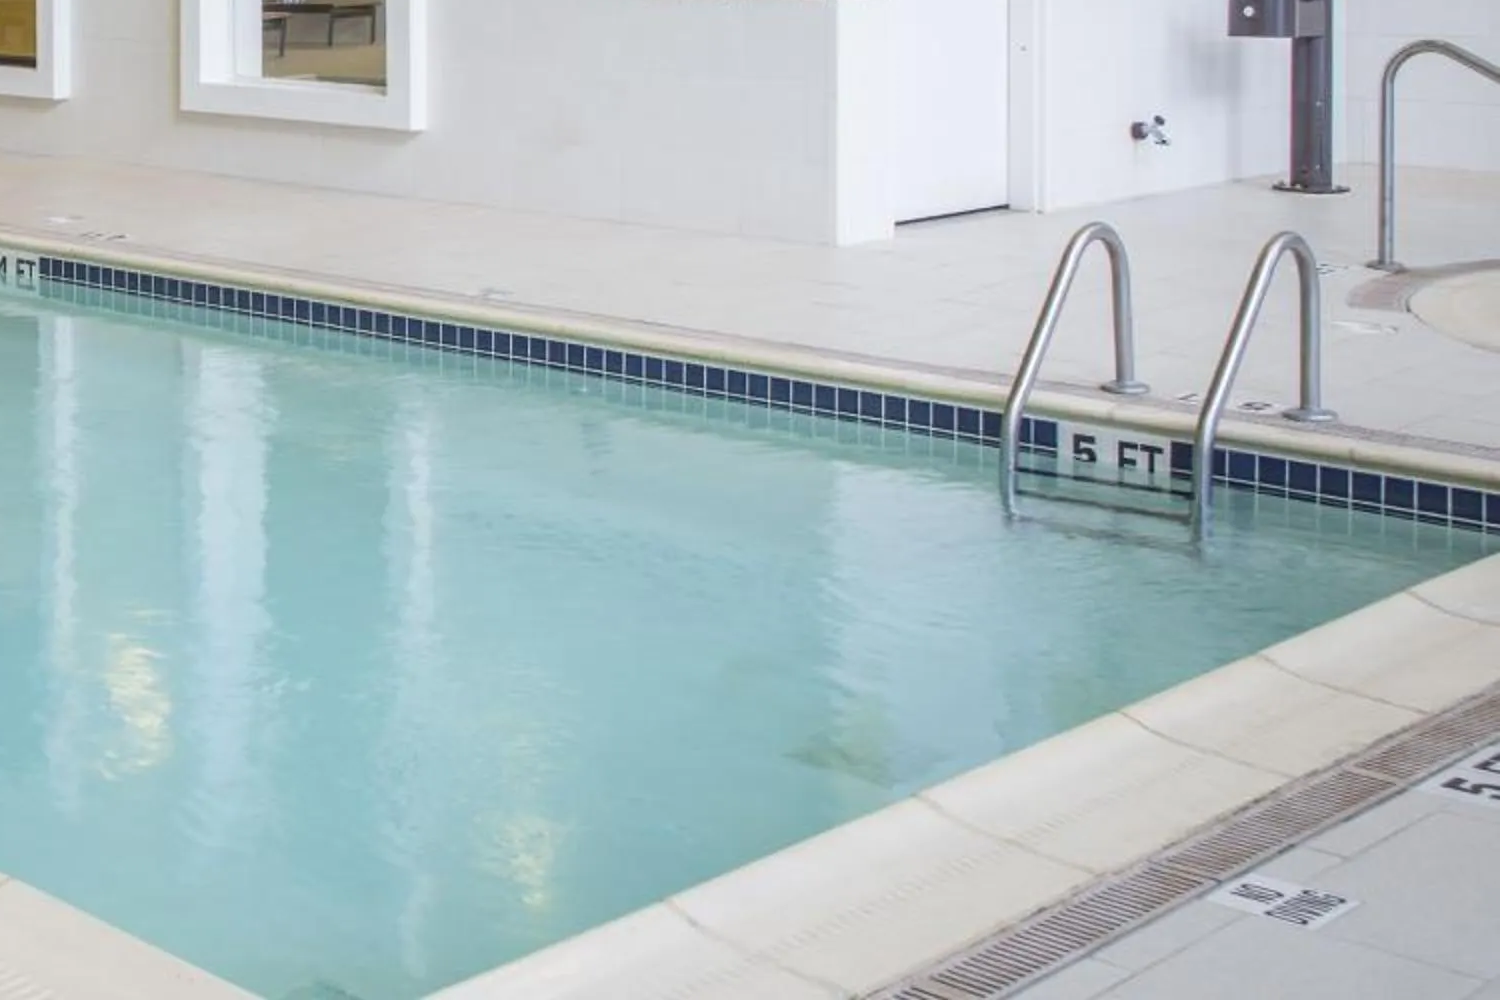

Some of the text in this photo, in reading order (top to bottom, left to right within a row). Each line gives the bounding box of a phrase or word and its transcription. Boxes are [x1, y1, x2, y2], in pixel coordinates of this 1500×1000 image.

[16, 258, 37, 276] FT
[1073, 433, 1164, 473] 5 FT
